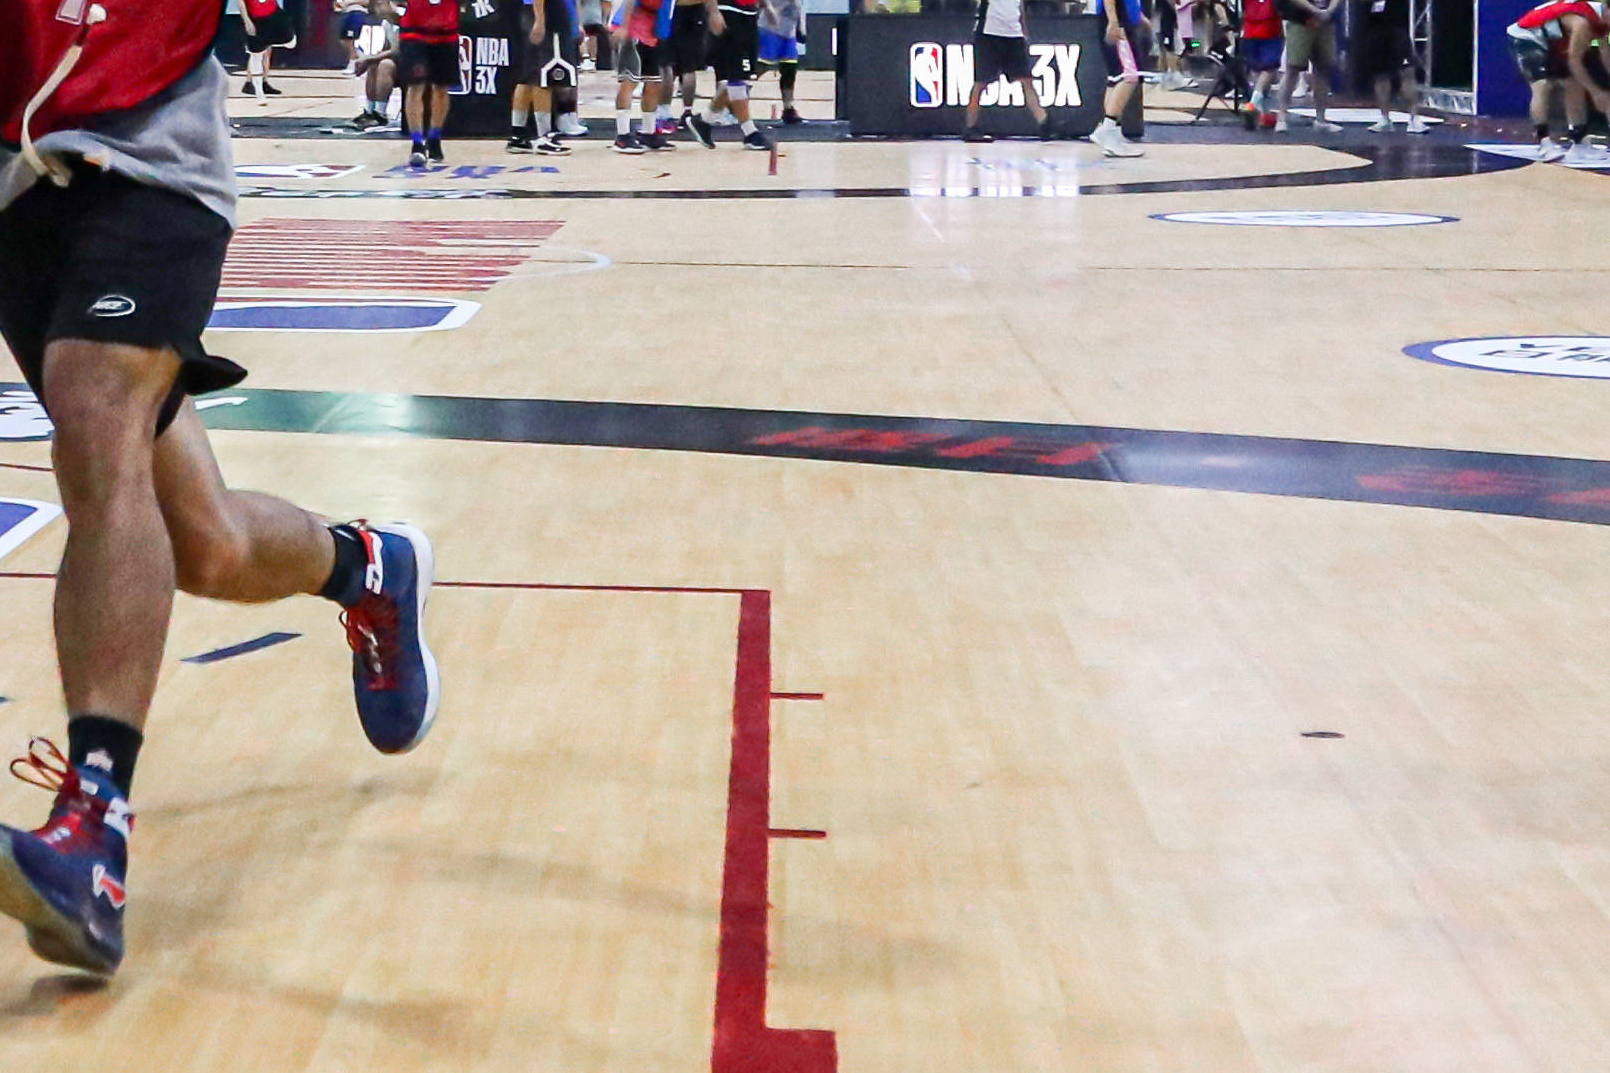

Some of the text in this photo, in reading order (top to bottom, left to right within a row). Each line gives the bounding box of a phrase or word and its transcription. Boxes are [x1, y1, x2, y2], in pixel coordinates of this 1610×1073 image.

[475, 36, 510, 67] NBA
[475, 66, 497, 95] 3X
[1028, 43, 1083, 108] 3X
